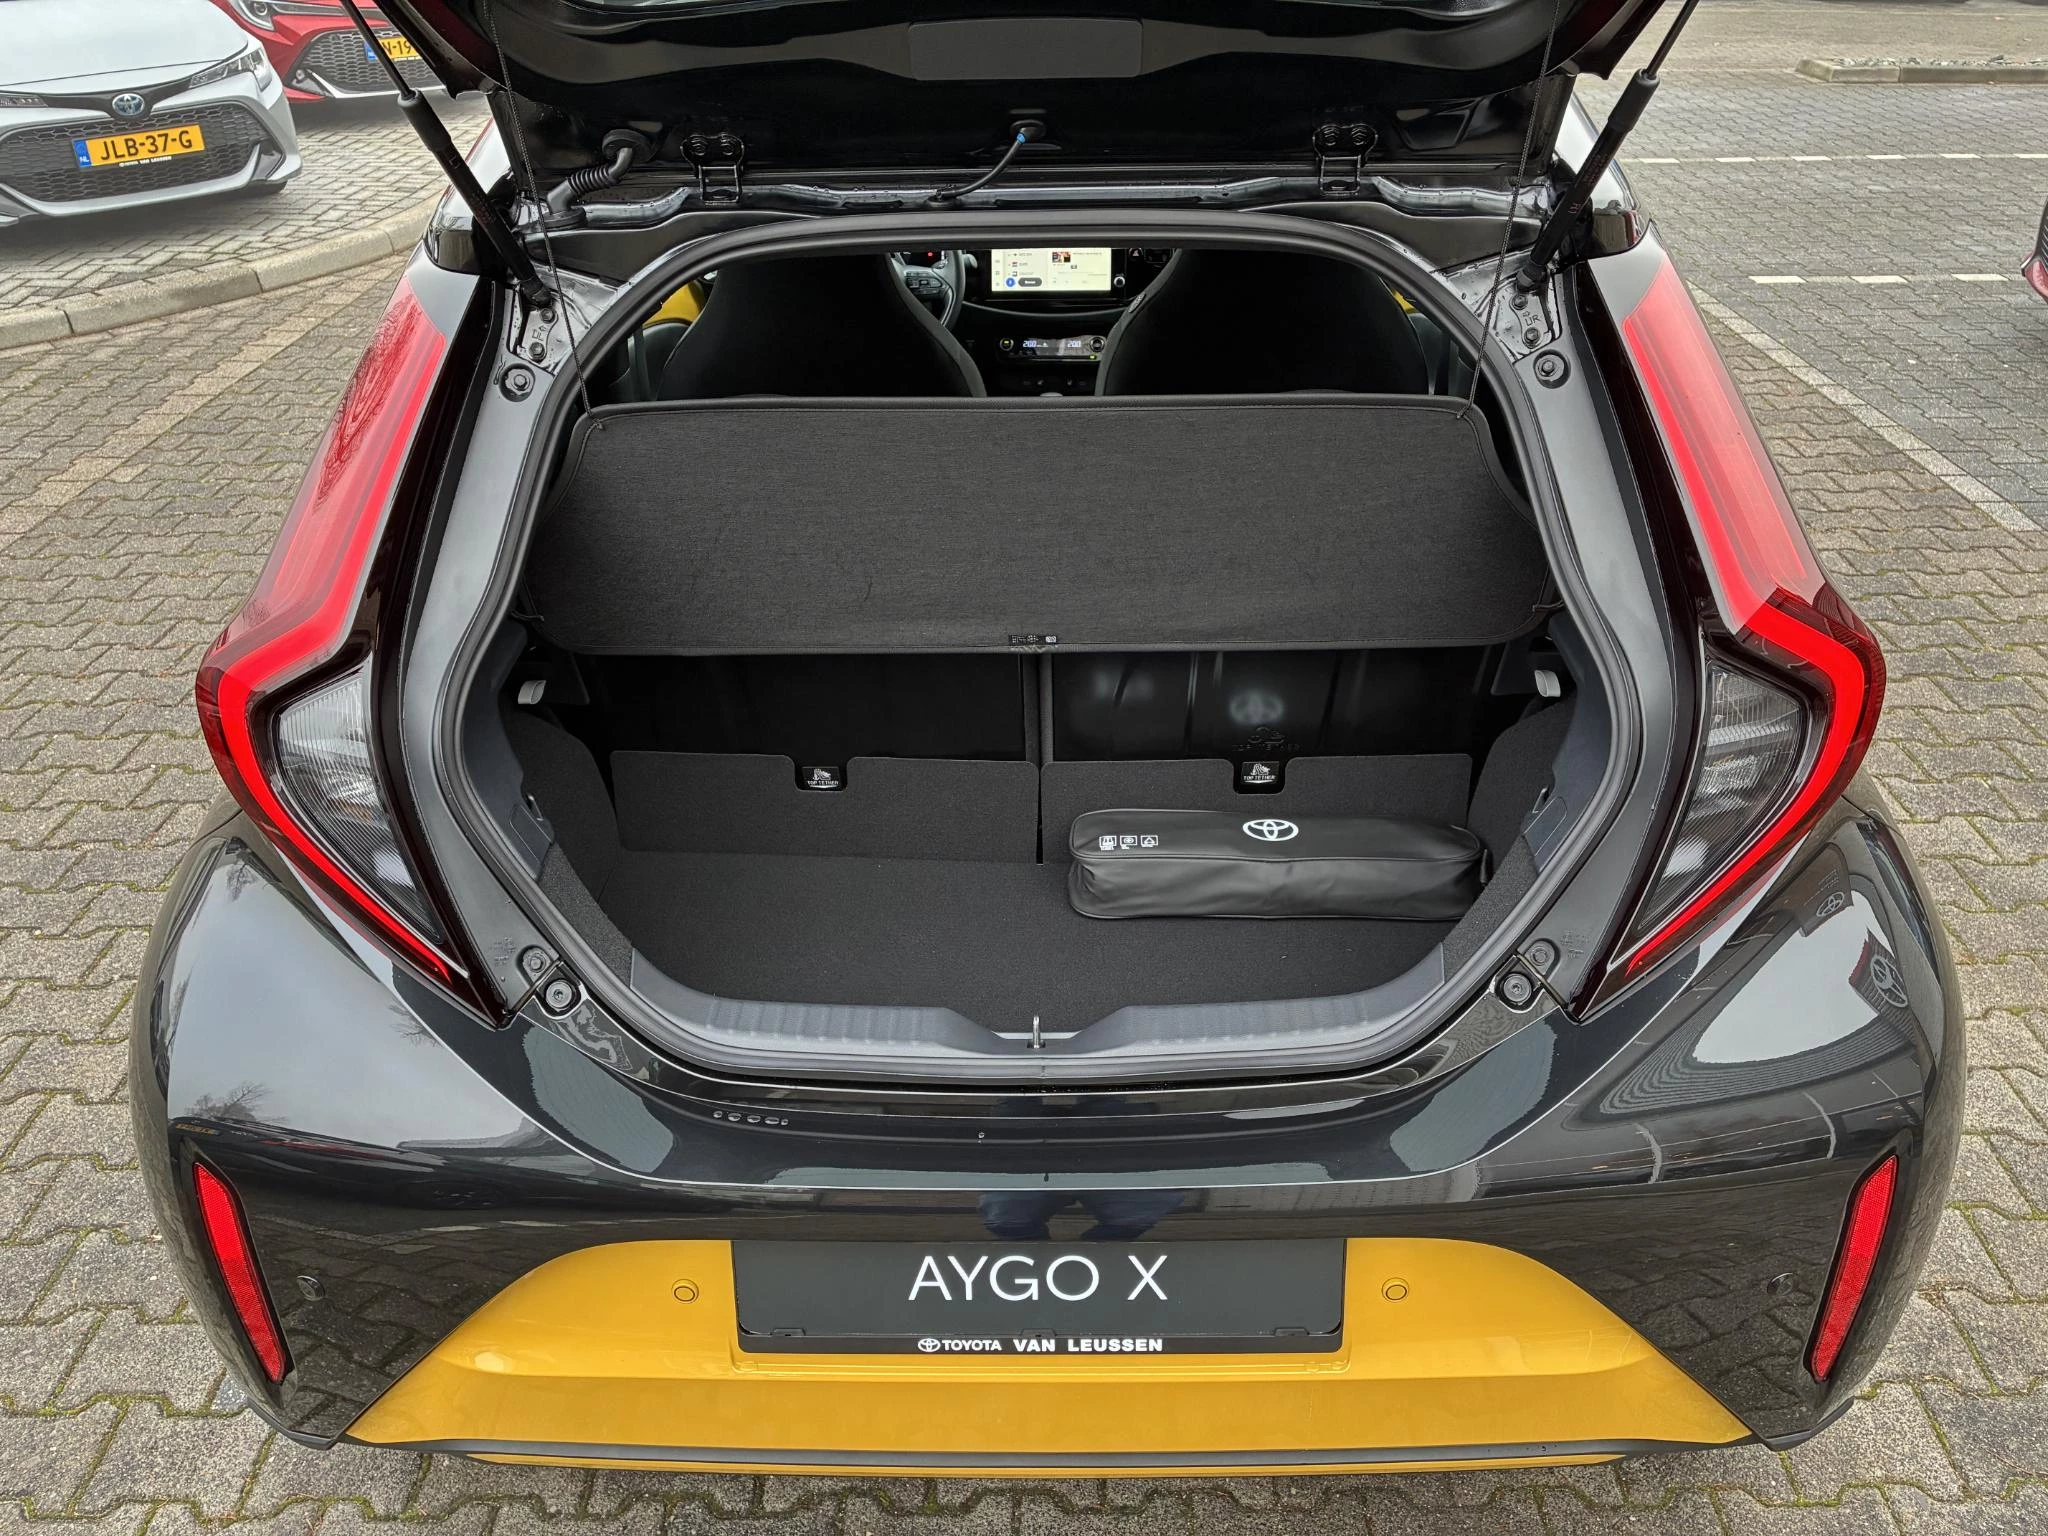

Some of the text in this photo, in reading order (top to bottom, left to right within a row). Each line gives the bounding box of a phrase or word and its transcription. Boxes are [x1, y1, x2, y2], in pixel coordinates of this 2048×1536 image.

[100, 129, 193, 160] JLB-37-G
[908, 1255, 1168, 1301] AYGO X
[942, 1339, 1163, 1352] TOYOTA VAN LEUSSEN
